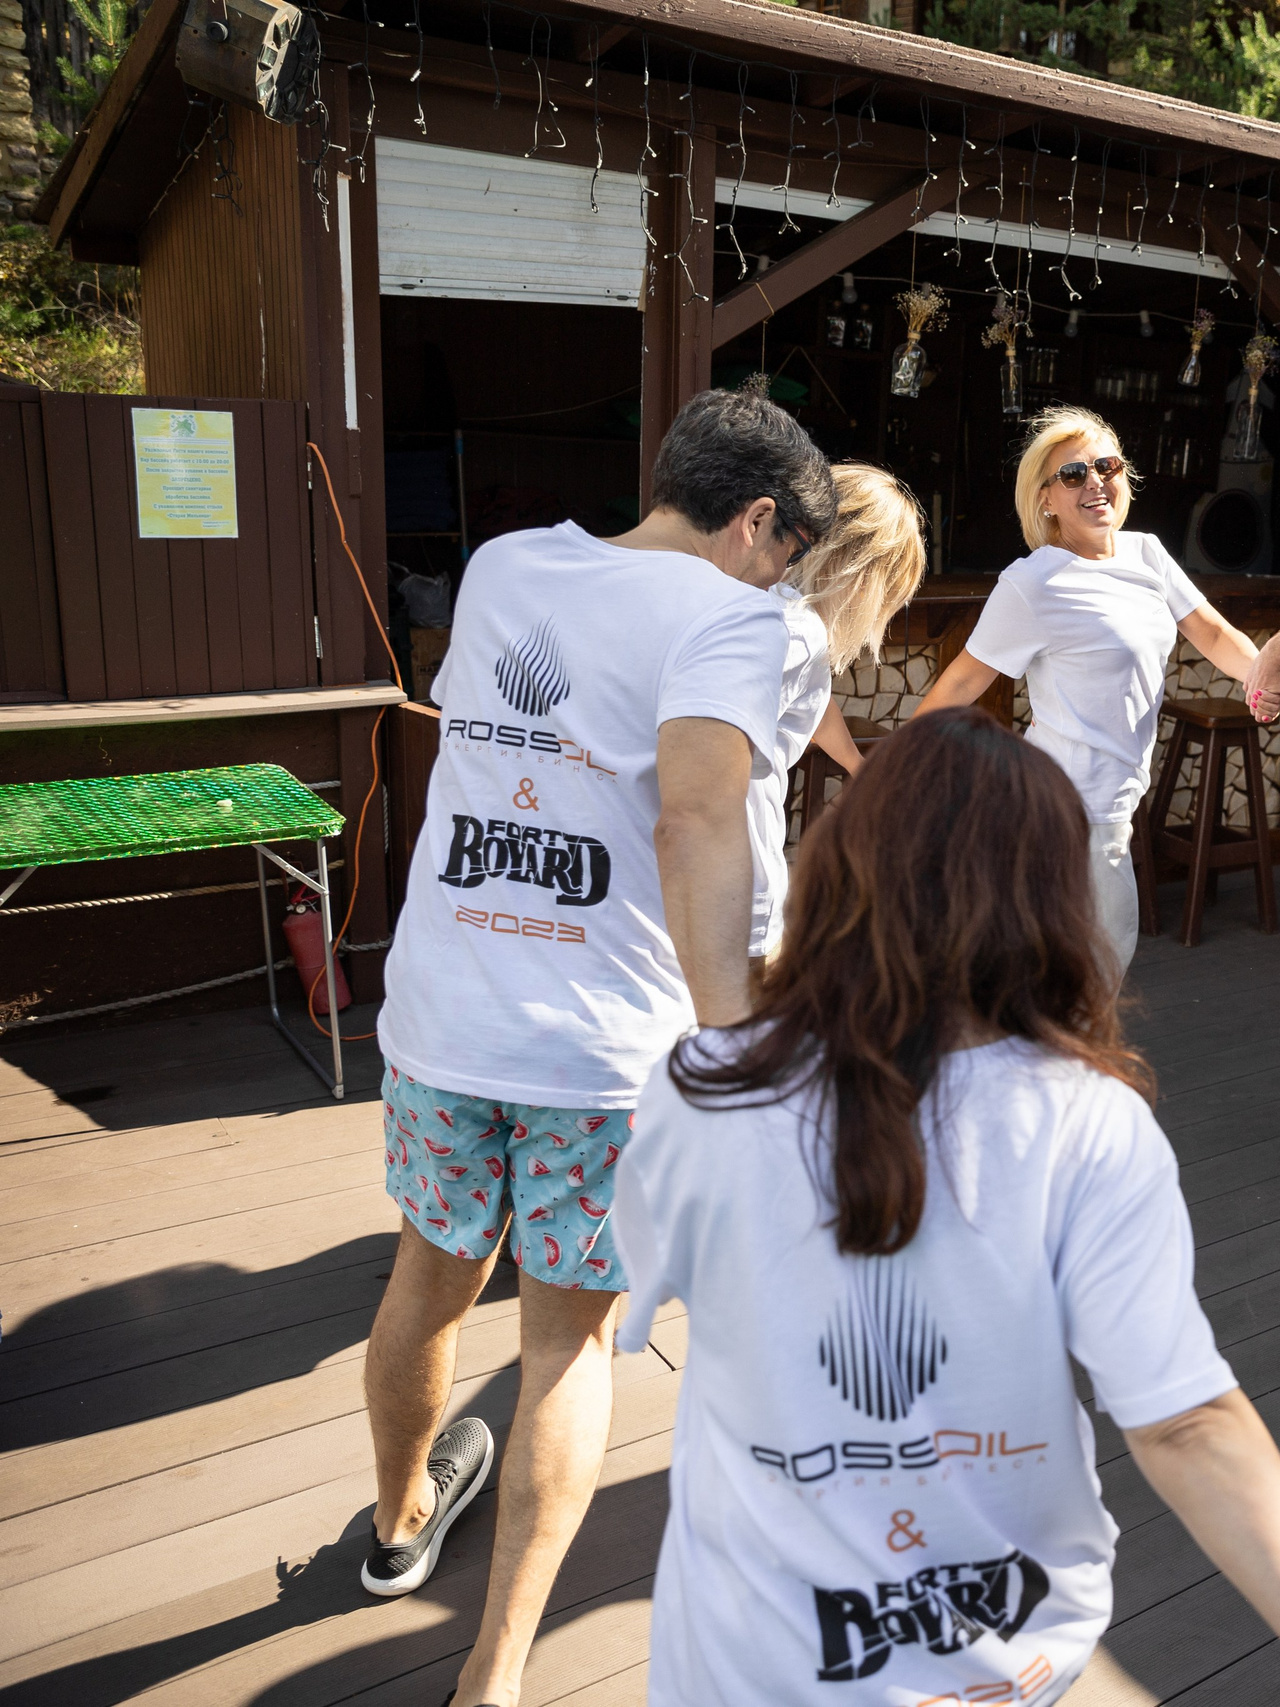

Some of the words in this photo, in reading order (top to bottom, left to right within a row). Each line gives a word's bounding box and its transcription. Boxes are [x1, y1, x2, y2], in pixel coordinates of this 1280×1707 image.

[512, 777, 541, 813] &
[485, 818, 567, 848] FORT
[437, 813, 612, 907] BOYARD
[455, 904, 586, 944] 2023
[886, 1509, 928, 1553] &
